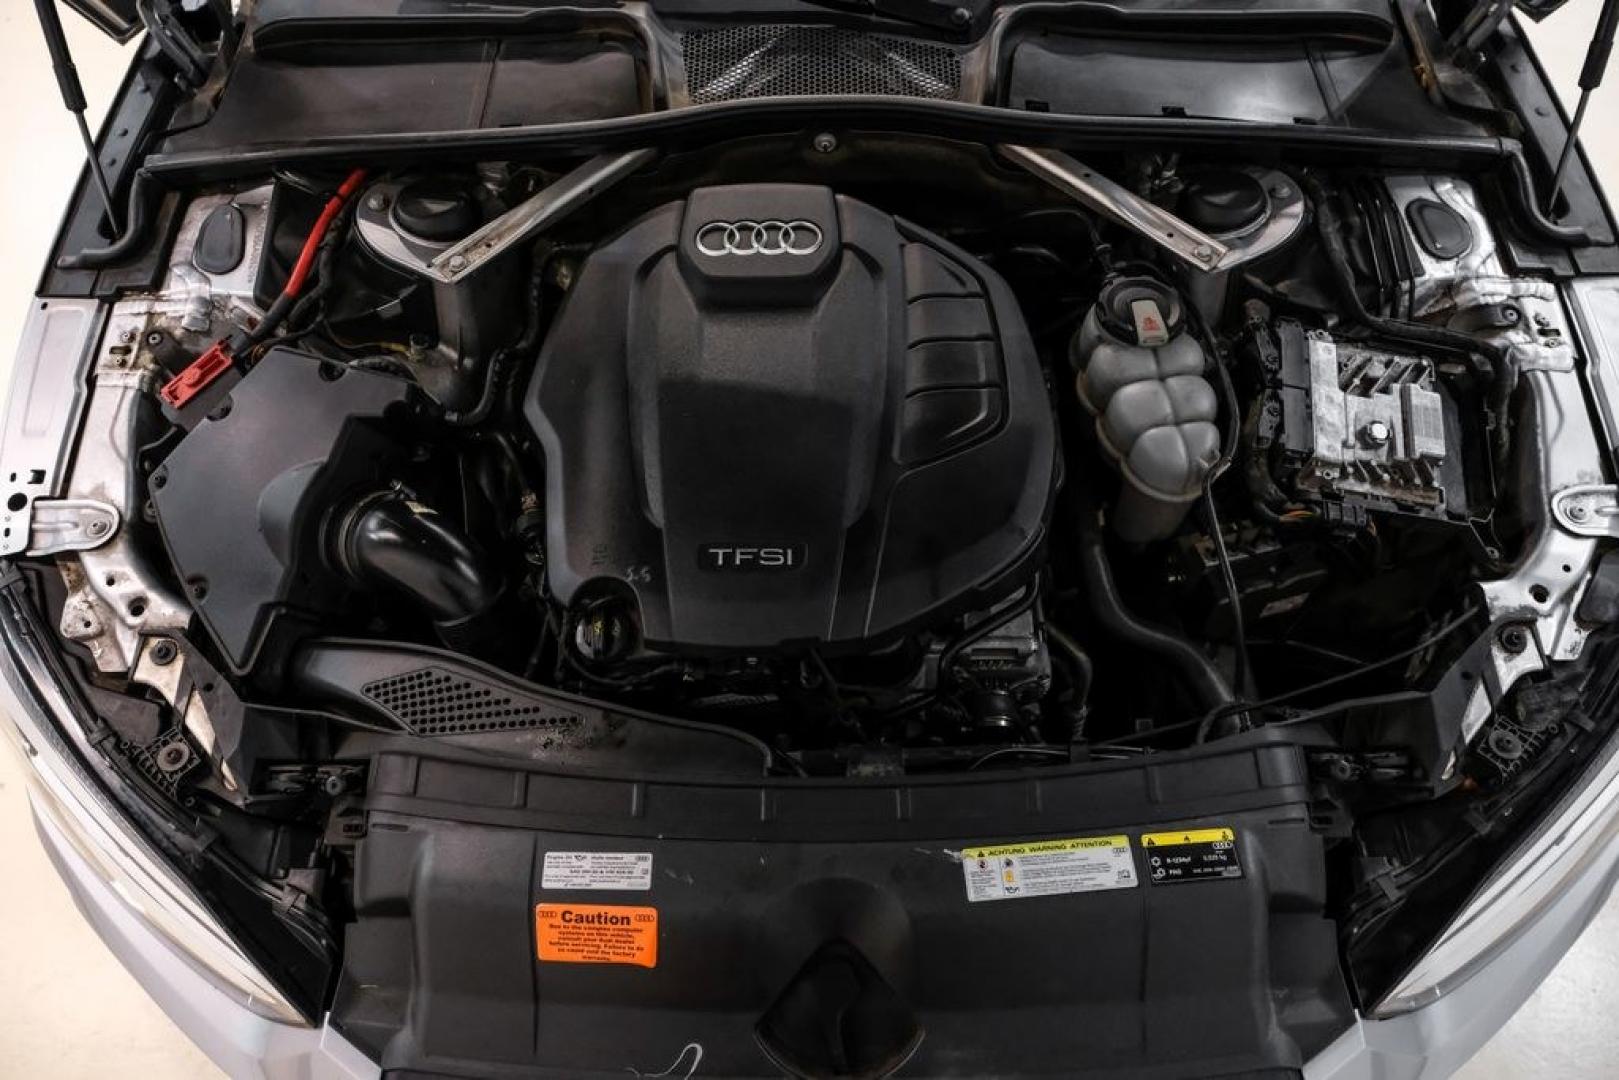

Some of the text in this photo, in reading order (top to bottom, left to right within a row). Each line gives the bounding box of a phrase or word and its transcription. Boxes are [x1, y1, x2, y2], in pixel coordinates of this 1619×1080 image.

[709, 548, 792, 565] TFSI
[988, 840, 1112, 856] ACHTUNG WARNING ATTENTION
[561, 910, 631, 925] Caution
